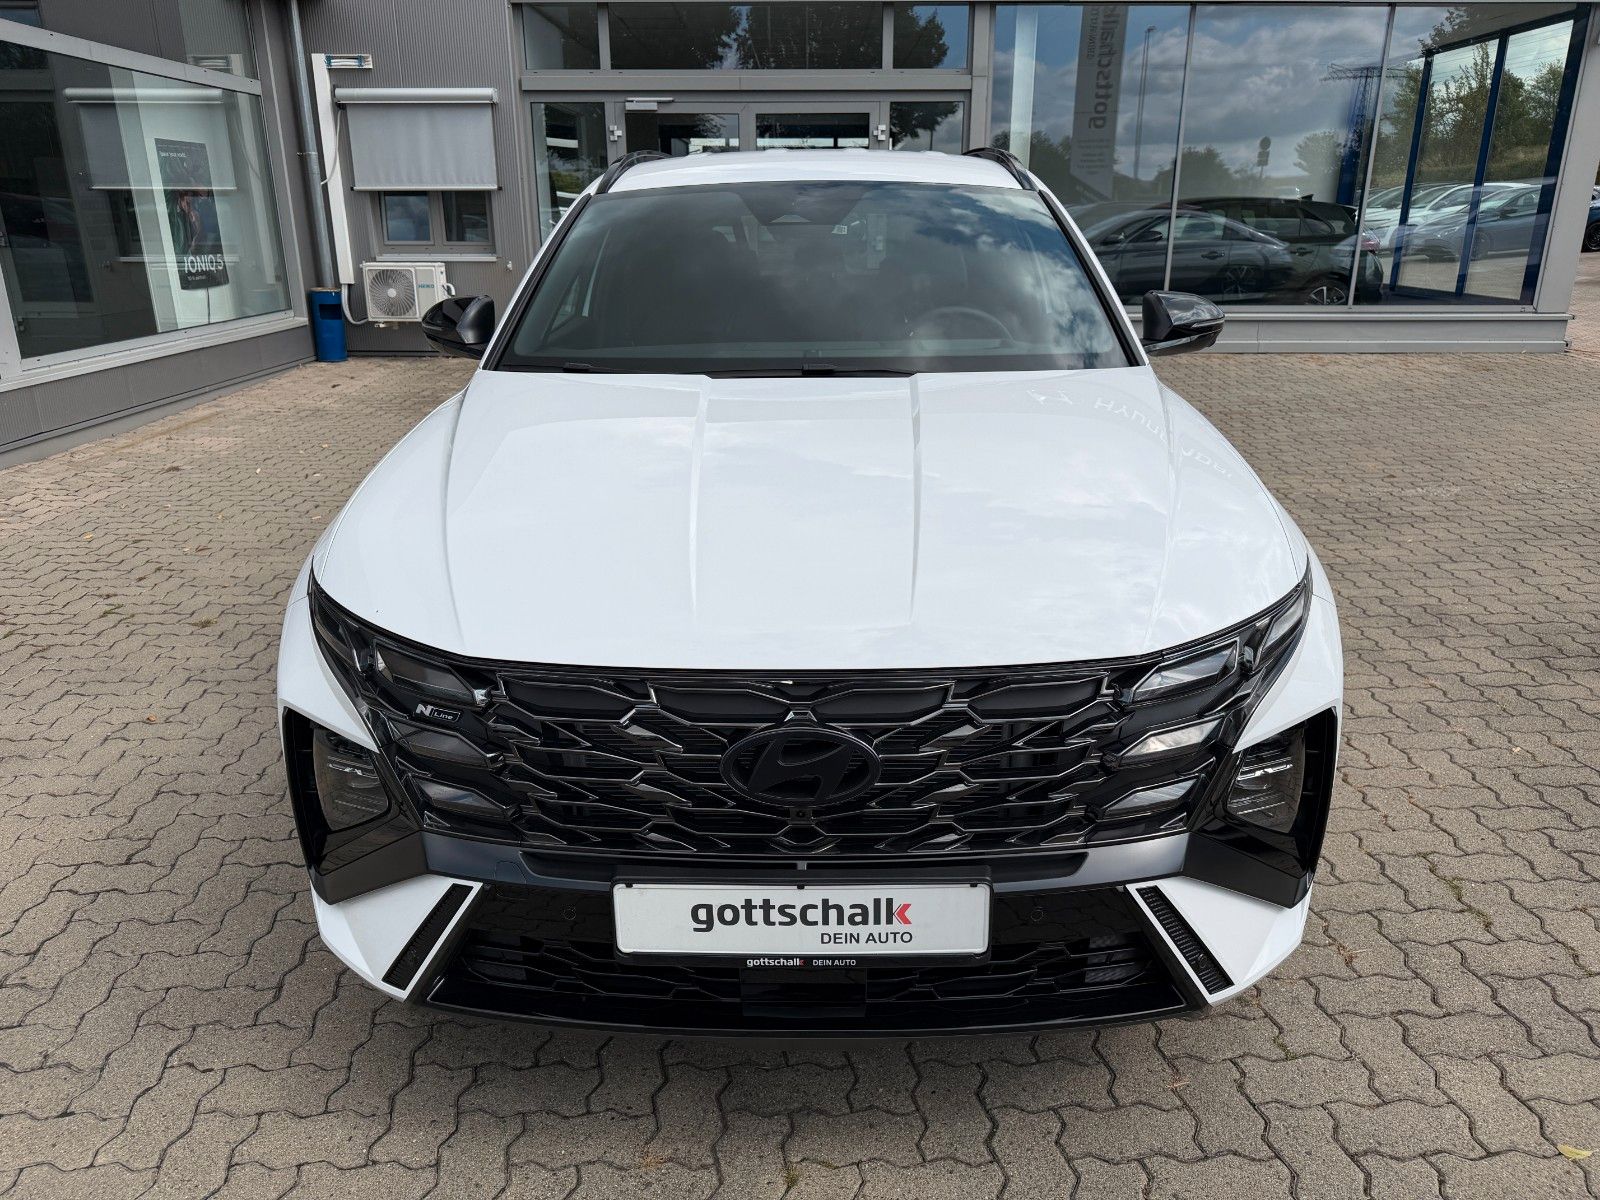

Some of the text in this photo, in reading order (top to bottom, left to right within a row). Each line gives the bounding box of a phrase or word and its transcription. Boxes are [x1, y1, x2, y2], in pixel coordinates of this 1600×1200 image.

[184, 254, 224, 273] IONIQ 5
[434, 711, 454, 720] Line
[691, 898, 913, 933] gottschalk
[821, 931, 913, 945] DEIN AUTO
[746, 957, 857, 968] gottschalk DEIN AUTO
